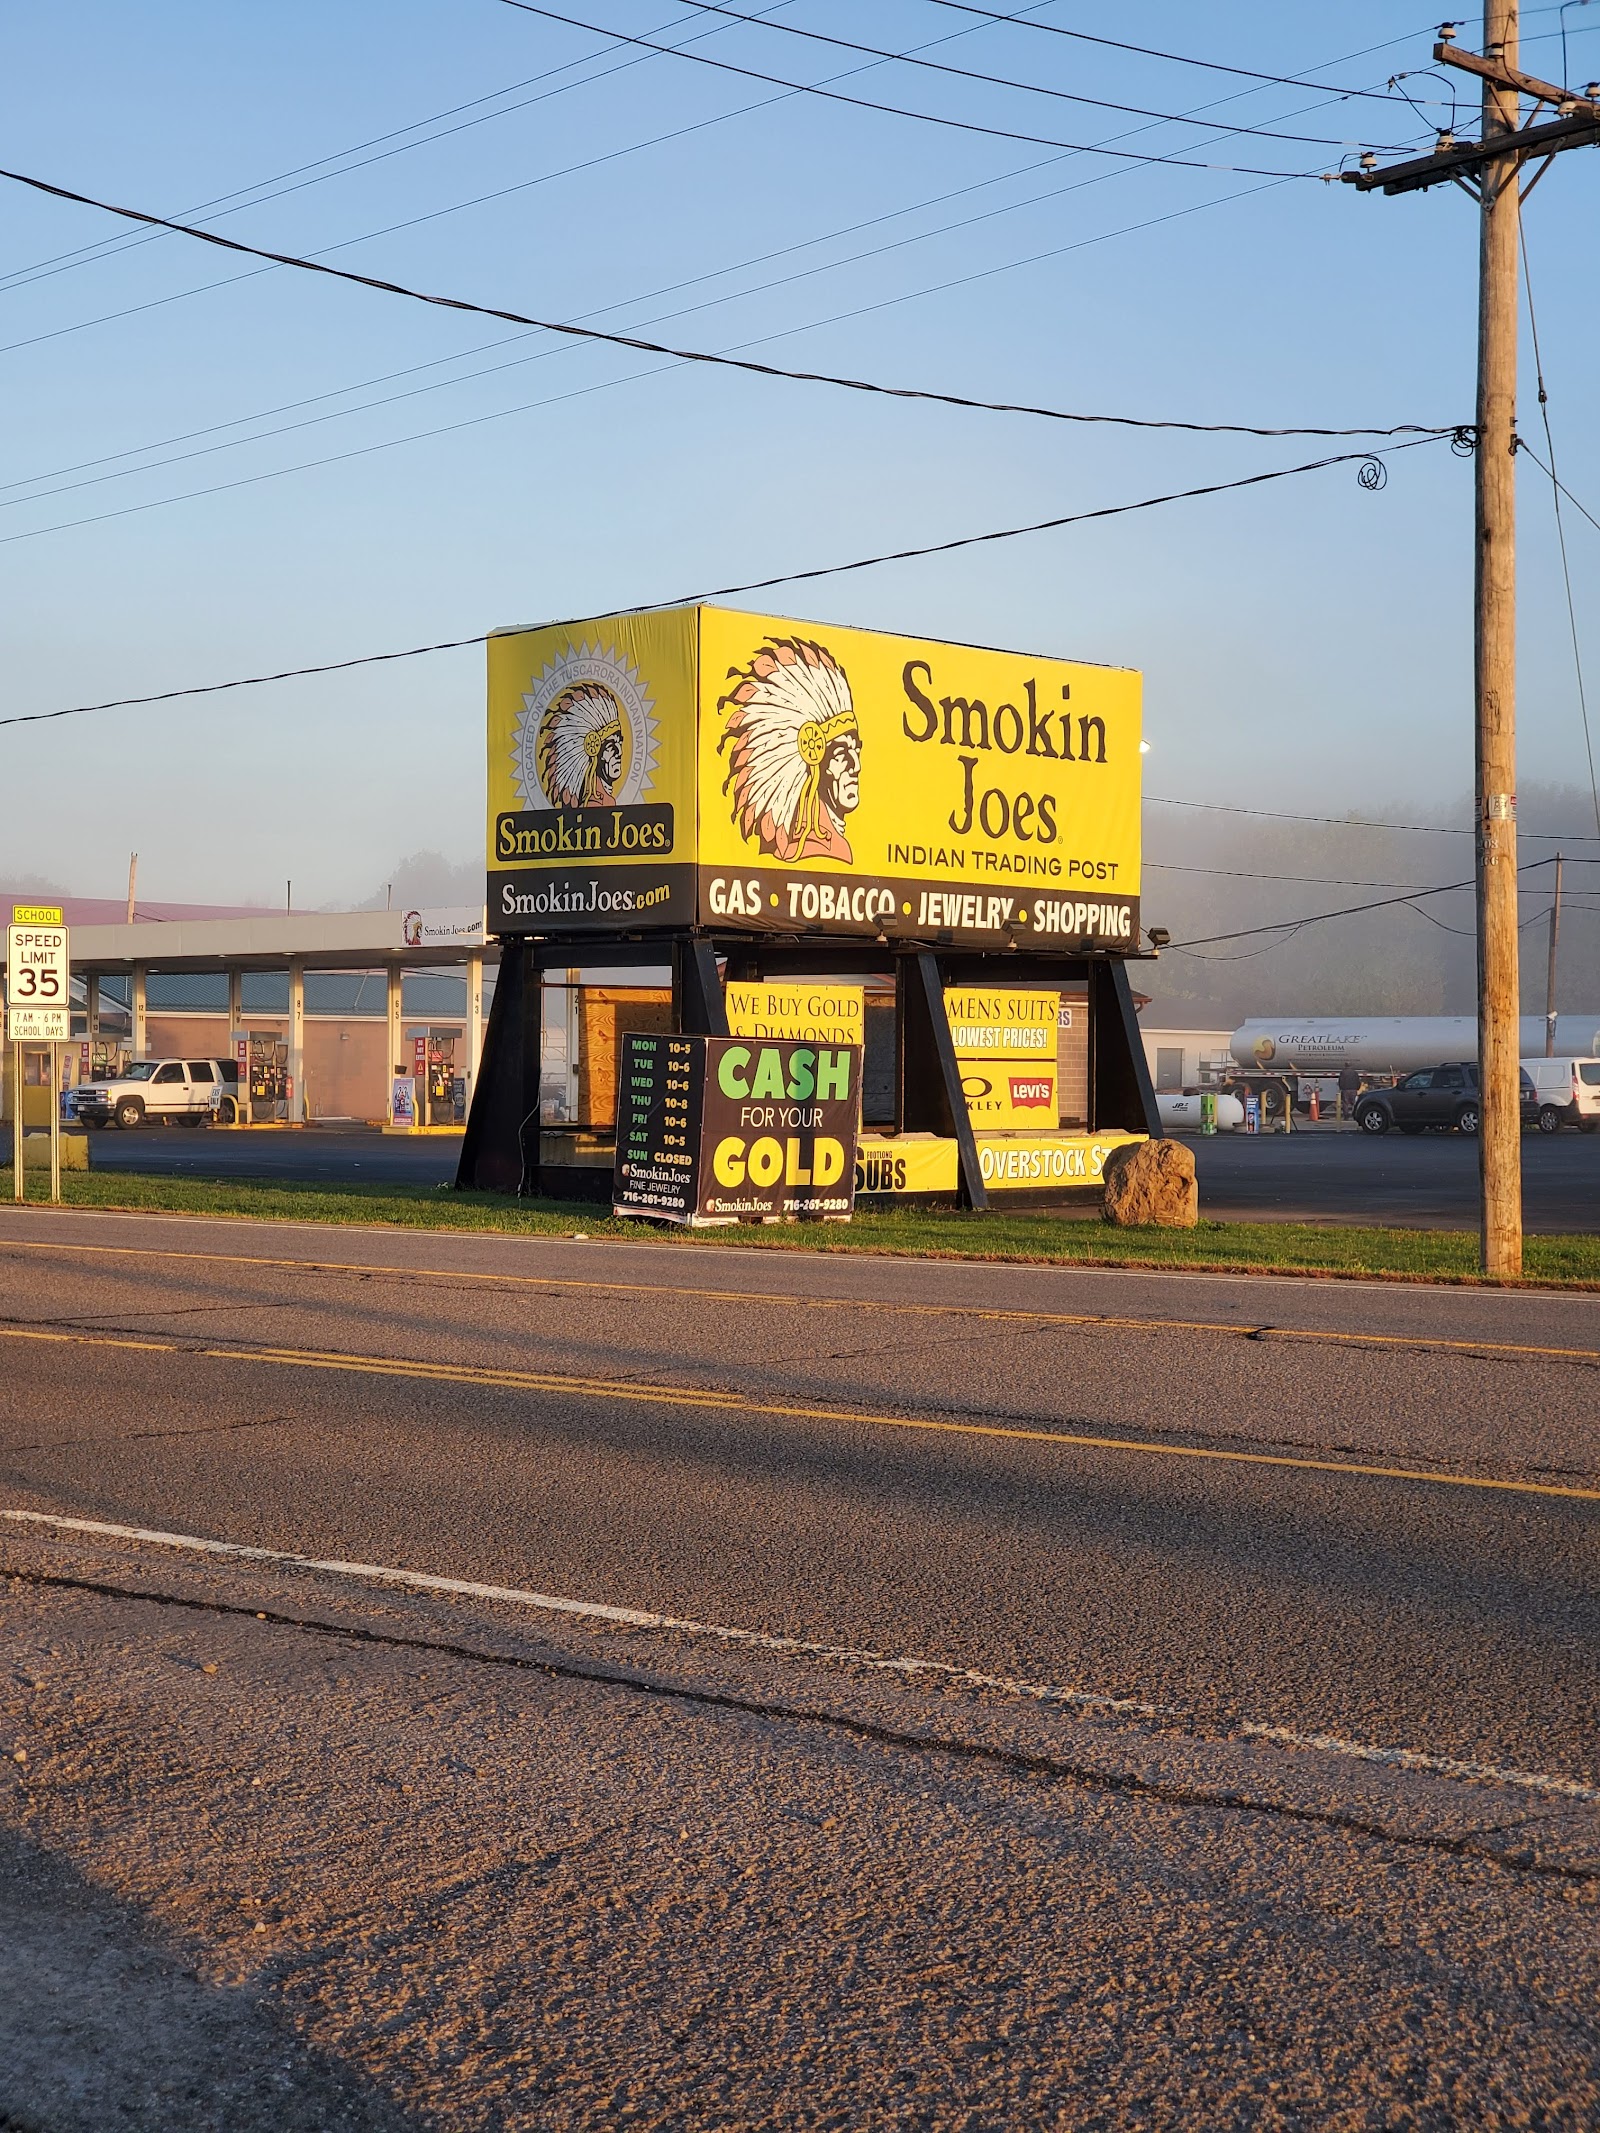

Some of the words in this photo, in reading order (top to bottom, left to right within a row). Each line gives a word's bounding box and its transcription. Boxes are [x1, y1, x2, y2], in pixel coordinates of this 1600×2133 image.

[559, 663, 622, 690] TUSCARORA
[543, 678, 560, 701] THE
[532, 704, 544, 722] ON
[619, 684, 642, 727] INDIAN
[902, 659, 1109, 764] Smokin
[525, 724, 538, 790] LOCATED
[630, 729, 645, 783] NATION
[948, 754, 1058, 844] Joes
[500, 813, 602, 856] Smokin
[606, 811, 666, 850] Joes
[887, 843, 965, 869] INDIAN
[971, 850, 1062, 876] TRADING
[1068, 859, 1119, 881] POST
[16, 909, 59, 922] SCHOOL
[709, 878, 762, 916] GAS
[786, 882, 896, 922] TOBACCO
[917, 891, 1014, 930] JEWELRY
[1033, 899, 1131, 937] SHOPPING
[15, 934, 62, 948] SPEED
[21, 951, 56, 964] LIMIT
[17, 968, 59, 997] 35
[395, 1000, 400, 1008] 6
[474, 994, 479, 1002] 4
[730, 993, 760, 1015] WE
[766, 994, 803, 1016] BUY
[807, 996, 859, 1018] GOLD
[947, 997, 1001, 1020] MENS
[1007, 998, 1056, 1020] SUITS
[16, 1013, 20, 1022] 7
[23, 1013, 34, 1022] AM
[44, 1013, 48, 1022] 6
[52, 1014, 62, 1023] PM
[14, 1026, 42, 1036] SCHOOL
[46, 1026, 64, 1036] DAYS
[754, 1023, 855, 1044] DIAMONDS
[952, 1026, 1001, 1048] LOWEST
[1002, 1027, 1048, 1048] PRICES!
[632, 1040, 657, 1052] MON
[668, 1042, 691, 1054] 10-5
[634, 1058, 654, 1070] TUE
[668, 1061, 690, 1072] 10-6
[717, 1046, 850, 1100] CASH
[631, 1076, 654, 1088] WED
[666, 1080, 689, 1091] 10-6
[630, 1095, 652, 1106] THU
[664, 1098, 688, 1110] 10-8
[632, 1114, 648, 1124] FRI
[664, 1116, 687, 1128] 10-6
[740, 1106, 774, 1128] FOR
[778, 1107, 824, 1128] YOUR
[629, 1132, 648, 1142] SAT
[664, 1134, 686, 1146] 10-5
[627, 1150, 648, 1160] SUN
[654, 1152, 692, 1166] CLOSED
[713, 1136, 845, 1188] GOLD
[866, 1150, 892, 1160] FOOTLONG
[979, 1146, 1086, 1181] OVERSTOCK
[630, 1163, 692, 1184] SmokinJoes
[630, 1180, 646, 1191] FINE
[647, 1182, 681, 1194] JEWELRY
[622, 1191, 686, 1208] 716-261-9280
[714, 1196, 774, 1213] SmokinJoes
[783, 1198, 849, 1211] 716-261-9280
